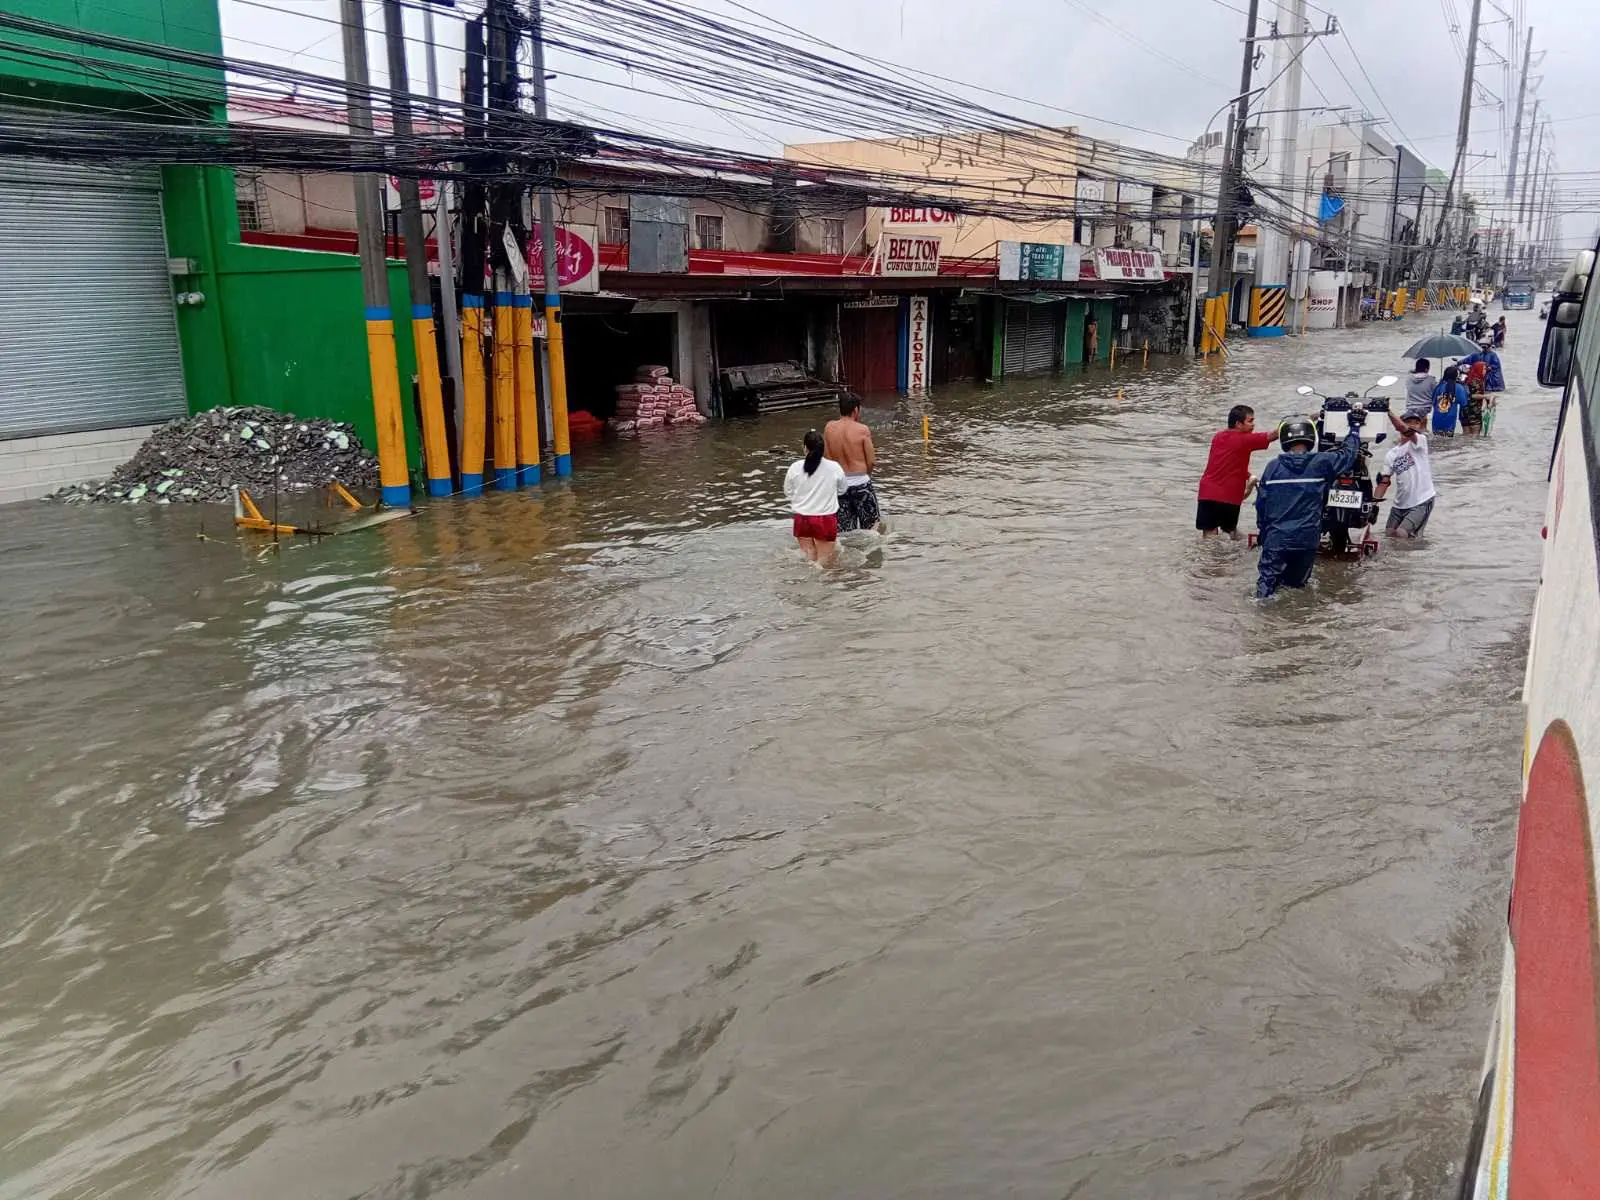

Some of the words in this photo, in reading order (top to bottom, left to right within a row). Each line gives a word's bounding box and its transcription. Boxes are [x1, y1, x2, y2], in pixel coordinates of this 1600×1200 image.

[890, 207, 956, 222] BELTON
[888, 239, 940, 260] BELTON
[886, 261, 912, 271] CUSTOM
[914, 262, 936, 271] TAILOR
